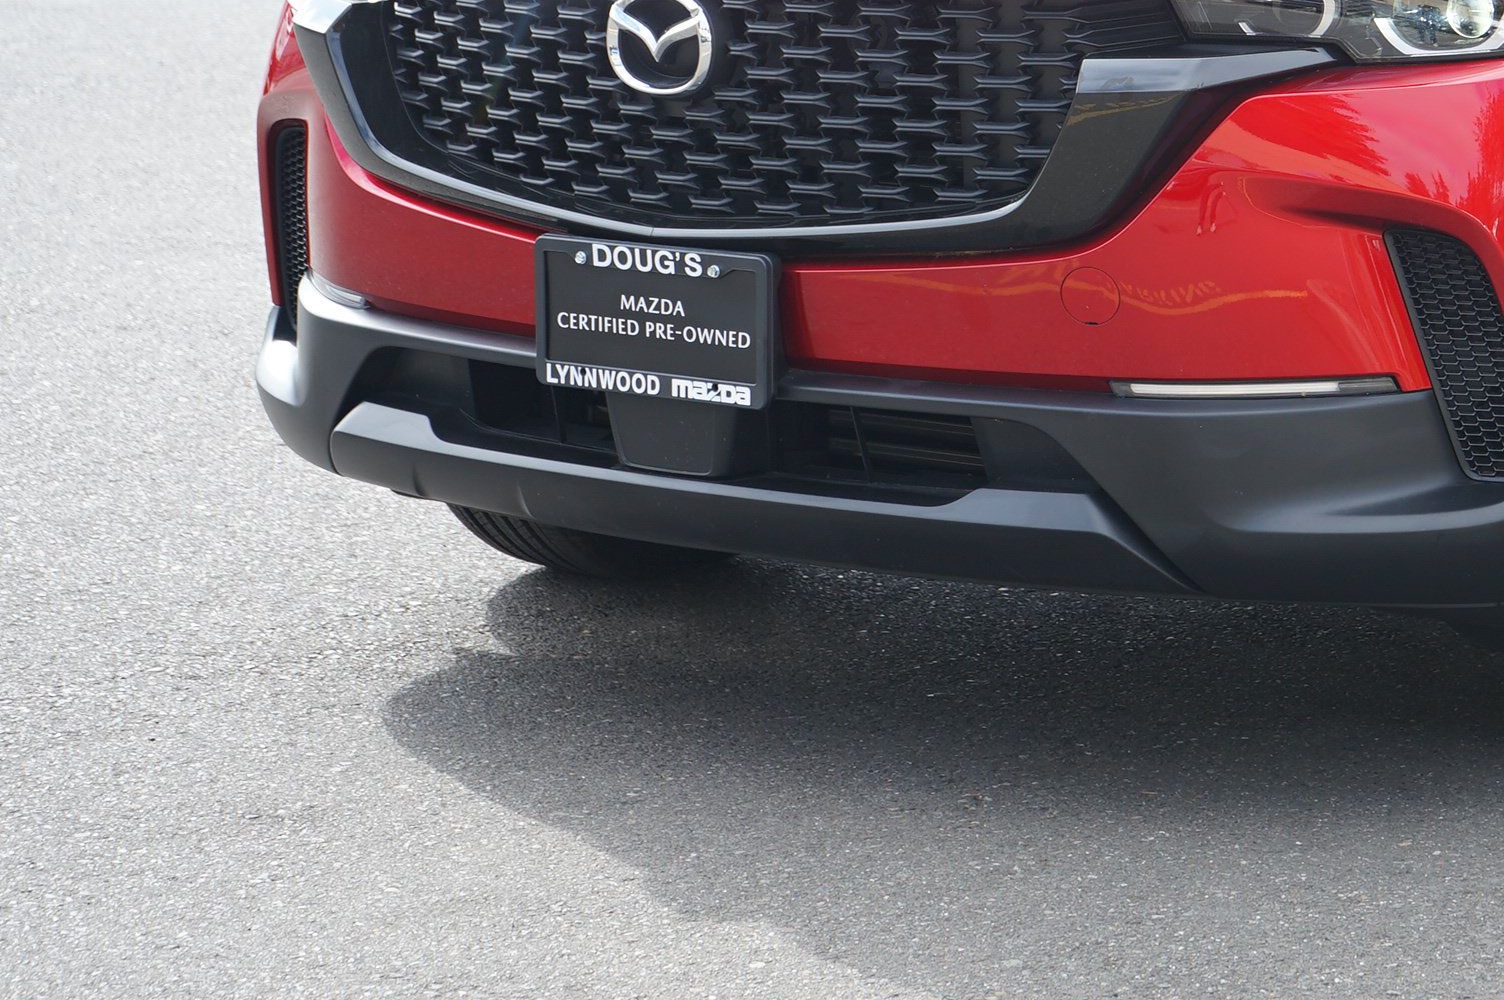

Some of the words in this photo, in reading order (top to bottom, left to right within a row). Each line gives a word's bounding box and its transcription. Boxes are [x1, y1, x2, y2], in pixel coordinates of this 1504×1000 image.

[591, 244, 703, 278] DOUG'S
[619, 294, 686, 317] MAZDA
[556, 311, 640, 337] CERTIFIED
[645, 321, 751, 350] PRE-OWNED
[545, 362, 661, 396] LYNNWOOD
[671, 378, 752, 407] mazda
